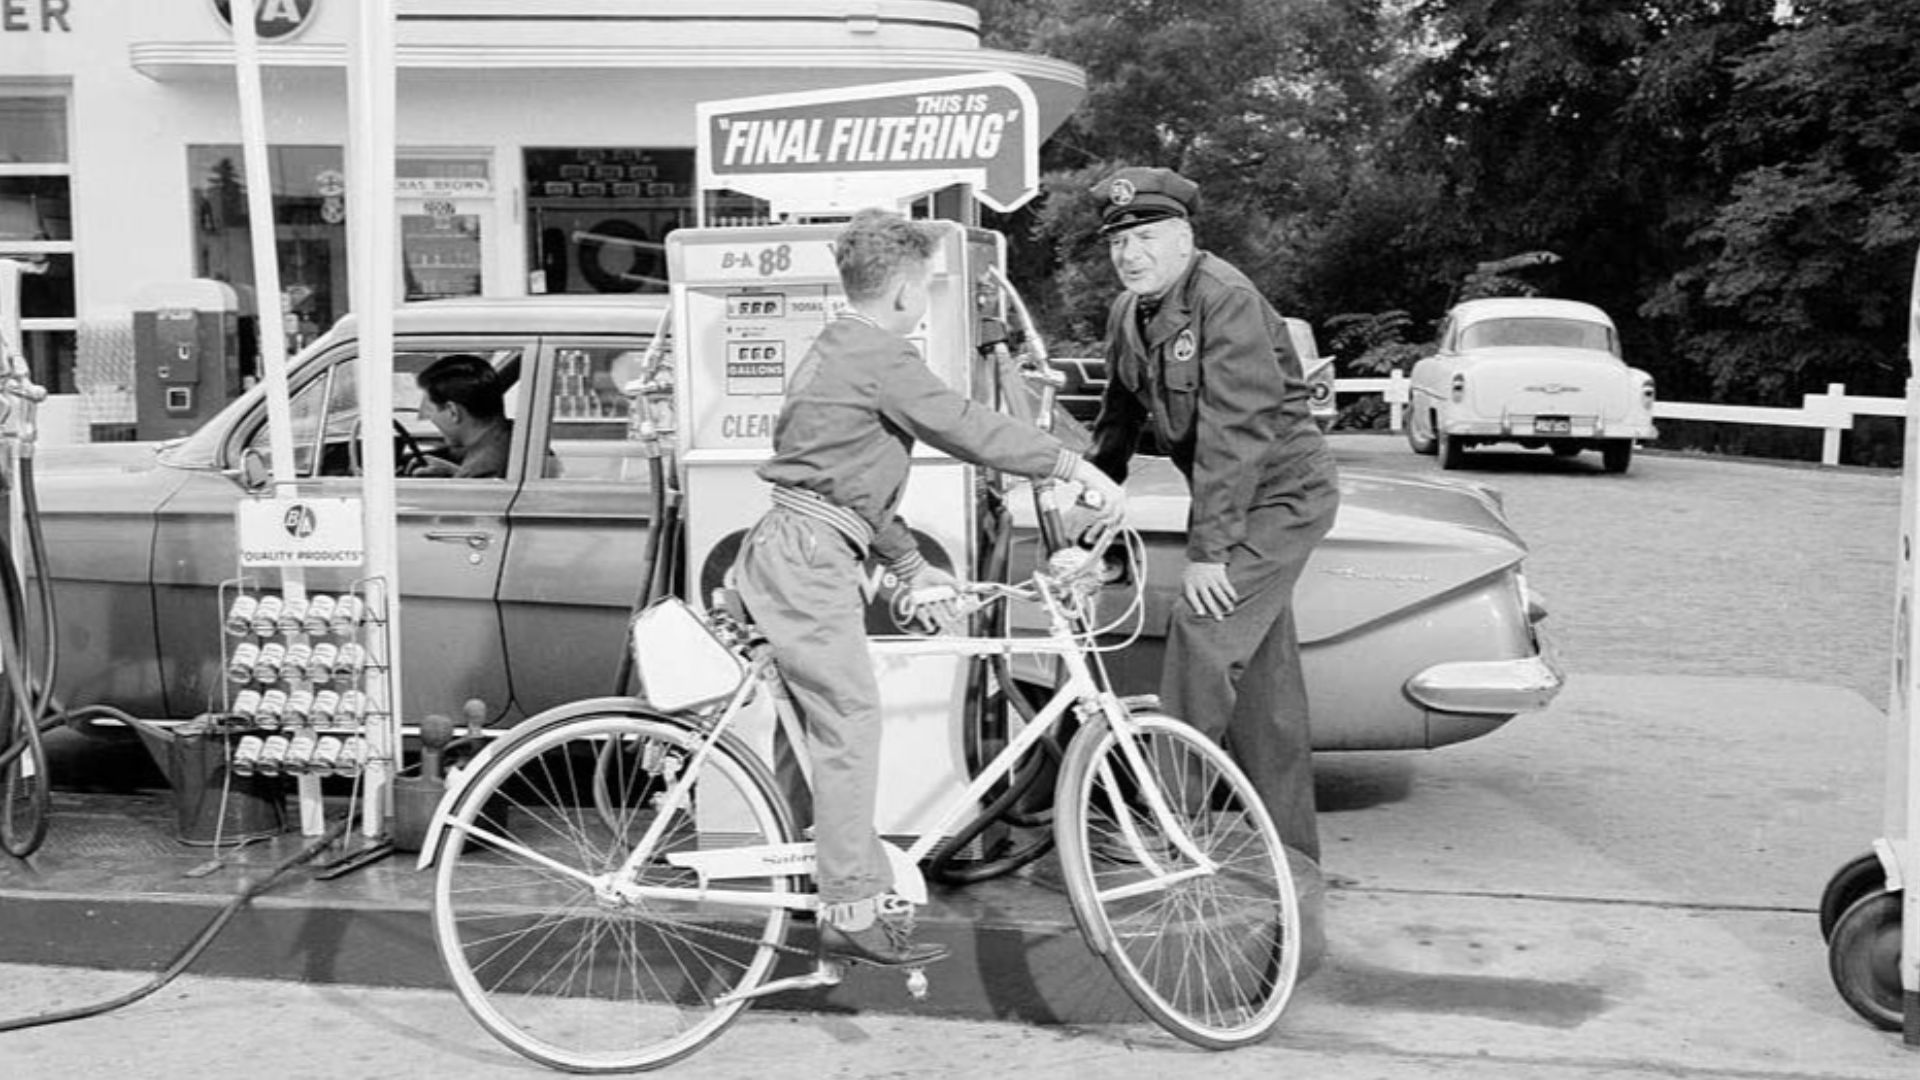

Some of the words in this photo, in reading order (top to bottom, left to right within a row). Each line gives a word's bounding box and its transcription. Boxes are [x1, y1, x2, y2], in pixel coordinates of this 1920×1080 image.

[916, 95, 963, 114] THIS
[965, 94, 989, 113] IS
[721, 251, 754, 269] B-A
[759, 244, 791, 276] 88
[729, 364, 784, 376] GALLONS
